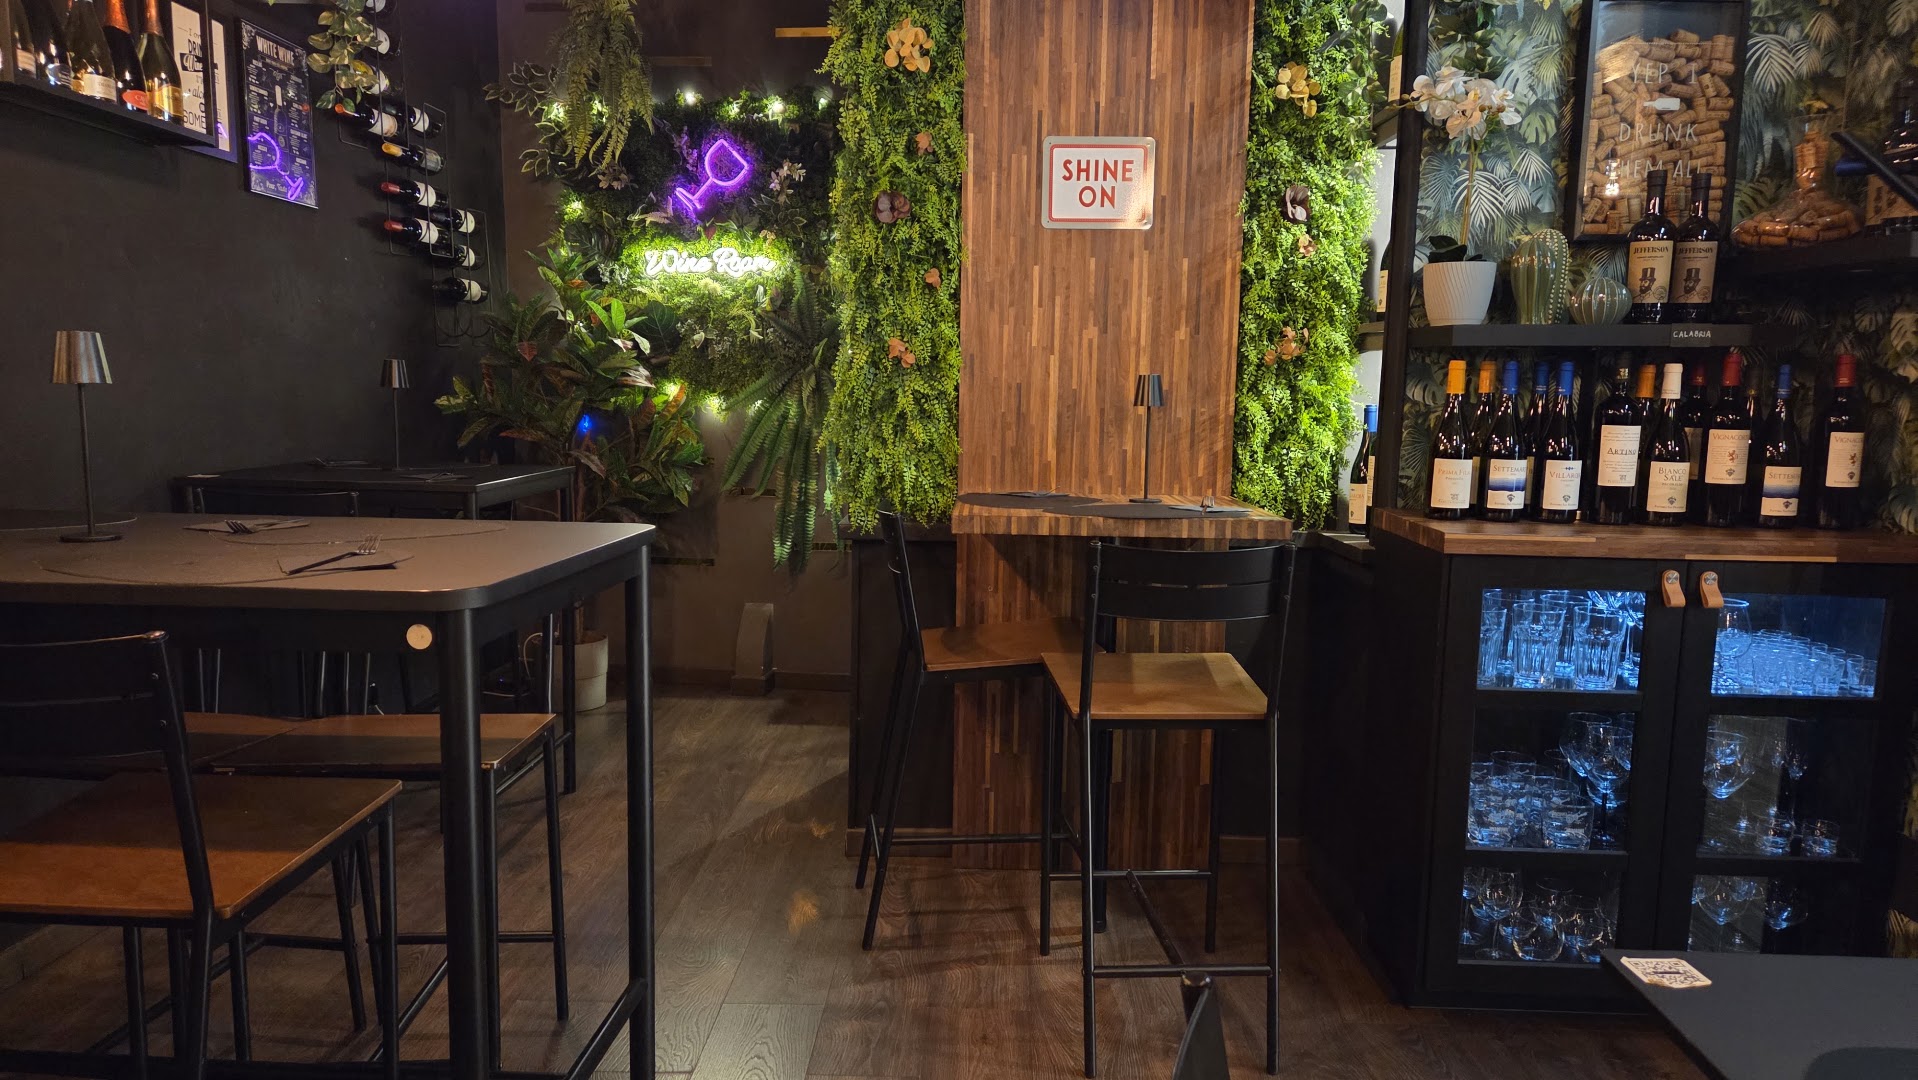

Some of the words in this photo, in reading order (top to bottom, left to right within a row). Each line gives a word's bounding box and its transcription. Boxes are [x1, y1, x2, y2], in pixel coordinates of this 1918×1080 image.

[255, 34, 278, 59] WHITE
[277, 45, 295, 67] WINE
[1632, 62, 1669, 85] YEP
[1689, 62, 1698, 85] I
[1618, 122, 1699, 143] DRUNK
[1061, 158, 1135, 183] SHINE
[1078, 183, 1116, 209] ON
[1633, 246, 1669, 255] JEFFERSON
[1678, 247, 1714, 255] JEFFERSON
[644, 249, 713, 276] Wine
[712, 247, 777, 278] Room
[1672, 330, 1712, 338] CALABRIA
[1658, 467, 1687, 475] BIANCO
[1663, 474, 1682, 482] SALE
